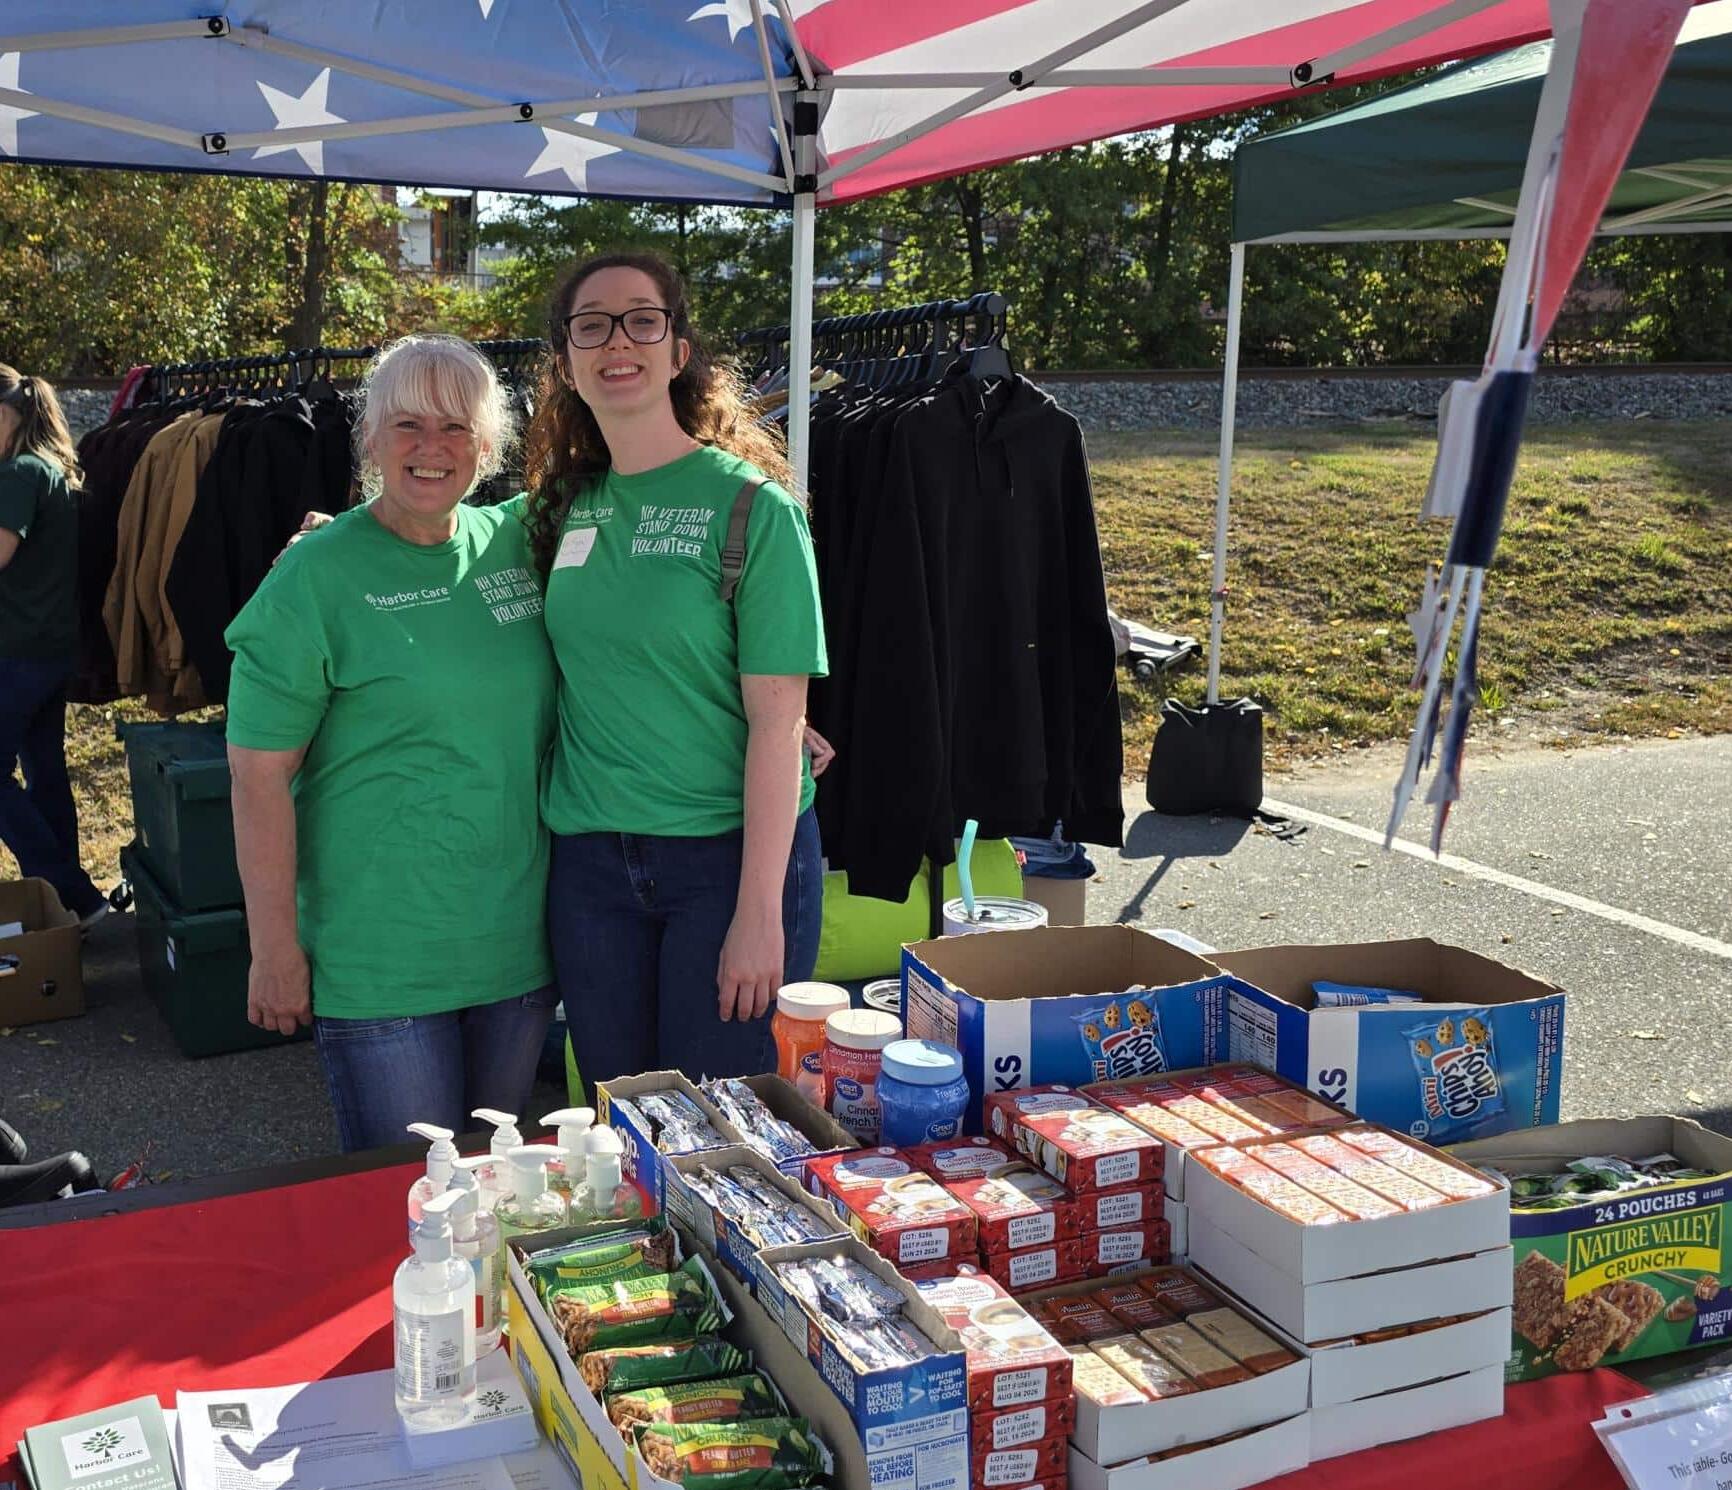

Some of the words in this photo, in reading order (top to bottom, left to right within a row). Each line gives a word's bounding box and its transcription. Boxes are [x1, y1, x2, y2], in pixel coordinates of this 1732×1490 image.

[596, 506, 614, 518] Care
[640, 505, 658, 521] NH
[659, 508, 715, 524] VETERAN
[636, 520, 670, 534] STAND
[672, 524, 708, 540] DOWN
[631, 537, 702, 557] VOLUNTEER
[474, 573, 492, 591] NH
[492, 568, 532, 587] VETERAN
[377, 591, 418, 606] Harbor
[421, 586, 449, 598] Care
[482, 584, 513, 605] STAND
[514, 580, 538, 598] DOWN
[1422, 1076, 1445, 1120] Mini
[847, 1104, 878, 1116] Cinna
[930, 1122, 953, 1133] Great
[1596, 1206, 1614, 1223] 24
[1618, 1191, 1696, 1218] POUCHES
[1711, 1188, 1724, 1198] BARS
[1575, 1226, 1649, 1268] NATURE
[1652, 1212, 1717, 1246] VALLEY
[578, 1262, 626, 1277] CRUNCHY
[1604, 1250, 1687, 1280] CRUNCHY
[1702, 1324, 1726, 1339] PACK
[928, 1368, 962, 1382] WAITING
[866, 1381, 903, 1394] WAITING
[866, 1394, 903, 1408] MOUTH
[930, 1395, 940, 1403] TO
[941, 1390, 962, 1400] COOL
[504, 1404, 524, 1414] Care
[868, 1407, 878, 1415] TO
[880, 1403, 904, 1413] COOL
[697, 1432, 752, 1444] CRUNCHY
[74, 1456, 114, 1470] Harbor
[118, 1449, 144, 1460] Care
[868, 1456, 895, 1467] REMOVE
[896, 1452, 913, 1461] FROM
[868, 1464, 884, 1473] FOIL
[886, 1459, 914, 1471] BEFORE
[134, 1464, 160, 1478] Us!
[870, 1467, 914, 1484] HEATING
[1667, 1461, 1693, 1480] This
